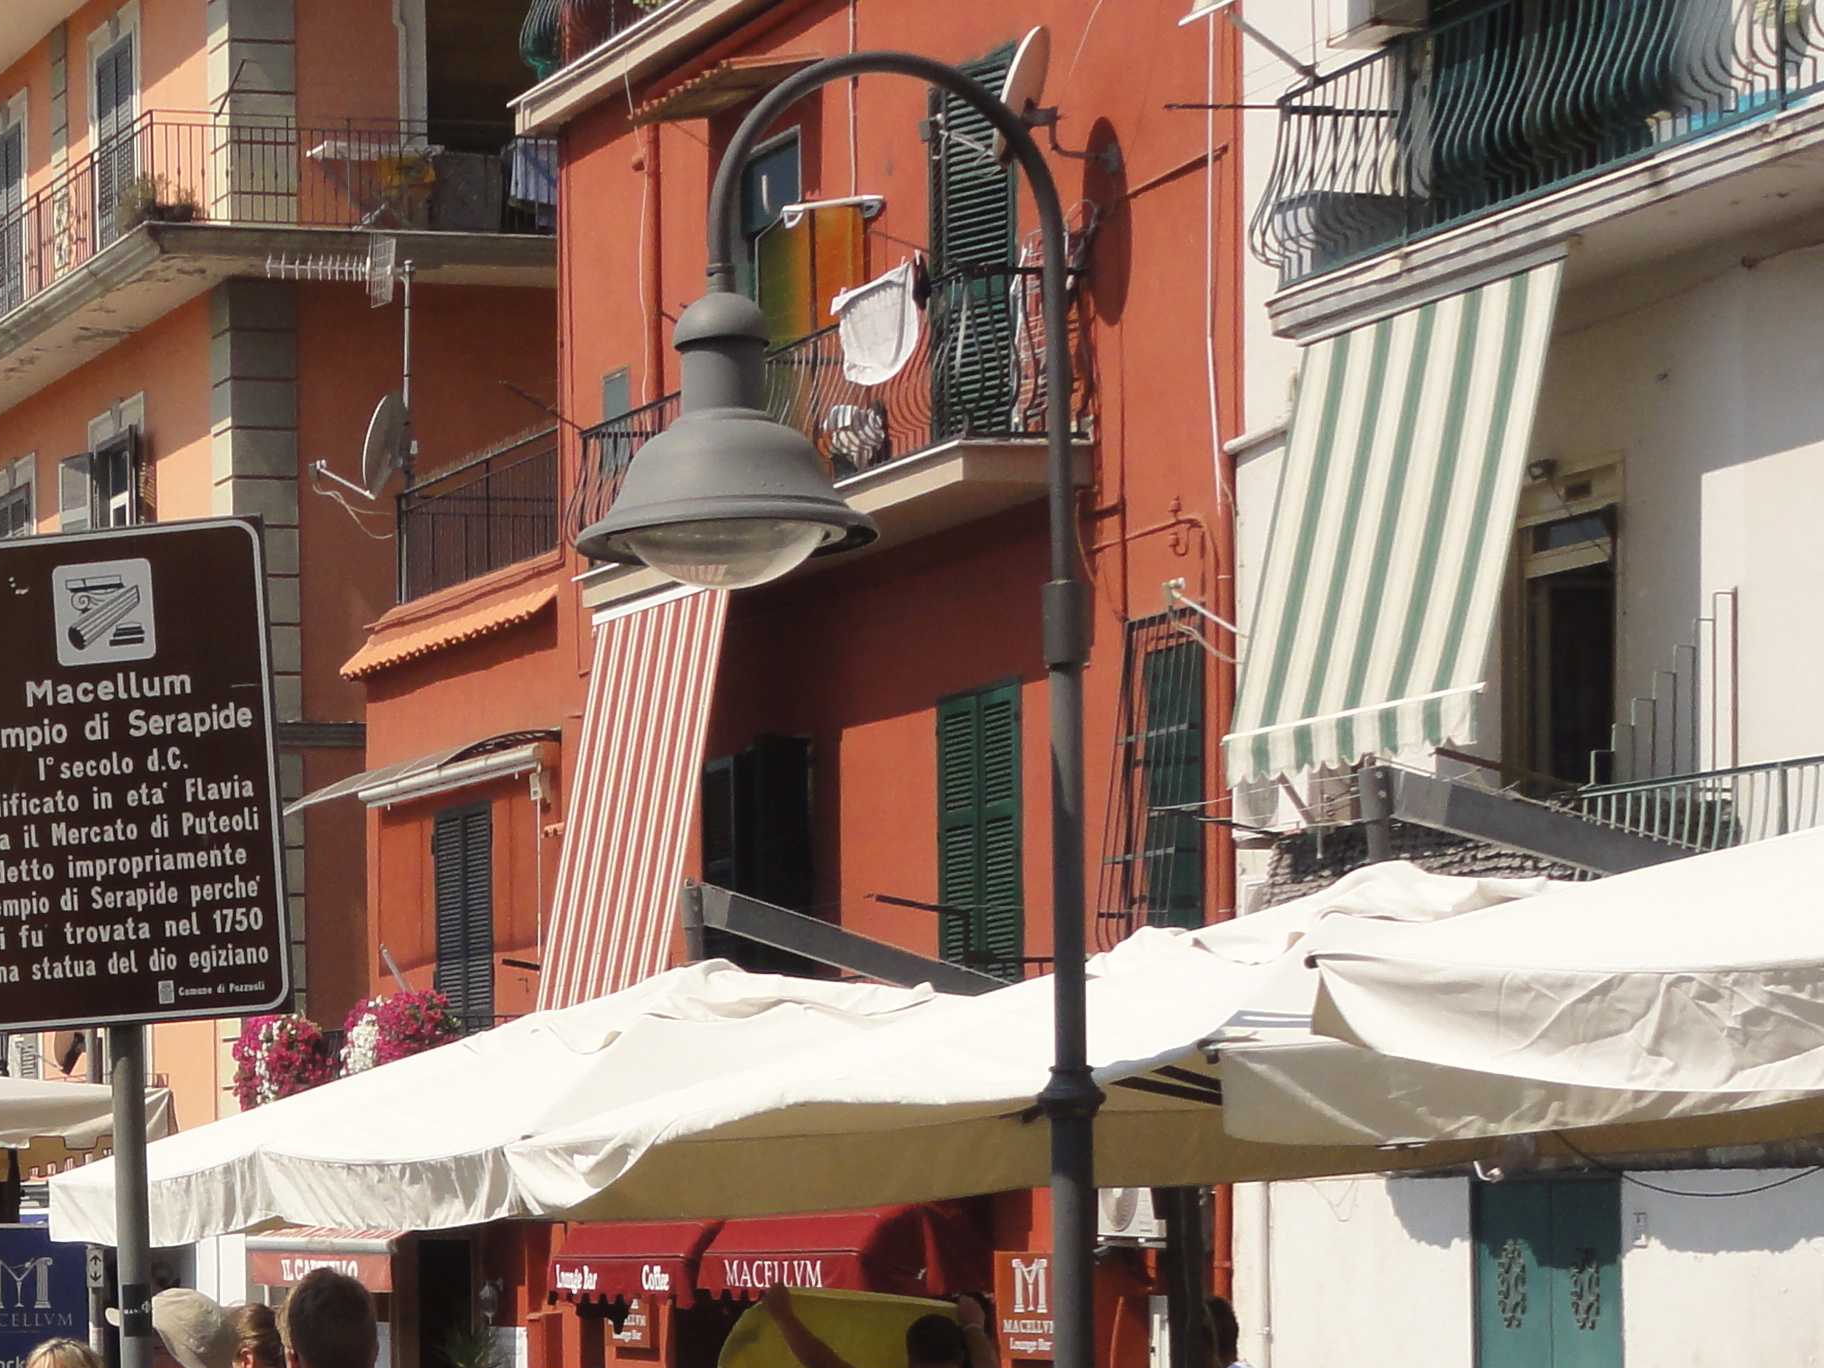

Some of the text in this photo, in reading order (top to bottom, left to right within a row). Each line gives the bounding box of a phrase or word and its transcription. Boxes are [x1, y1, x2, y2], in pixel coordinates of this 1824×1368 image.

[26, 671, 192, 707] Macellum
[84, 711, 110, 741] di
[128, 702, 253, 737] Serapide
[60, 751, 133, 779] secolo
[147, 747, 189, 773] d.C.
[92, 786, 113, 810] in
[185, 775, 254, 802] Flavia
[23, 825, 38, 849] il
[51, 817, 138, 847] Mercato
[150, 814, 169, 839] di
[181, 807, 259, 836] Puteoli
[67, 843, 247, 881] impropriamente
[60, 888, 79, 912] di
[91, 881, 178, 912] Serapide
[64, 917, 151, 945] trovata
[165, 911, 200, 937] nel
[213, 907, 264, 934] 1750
[32, 956, 97, 981] statua
[108, 950, 138, 975] del
[149, 947, 177, 972] dio
[189, 944, 268, 974] egiziano
[216, 983, 225, 995] di
[555, 1264, 598, 1294] Lounge Bar
[641, 1264, 670, 1291] Coffee
